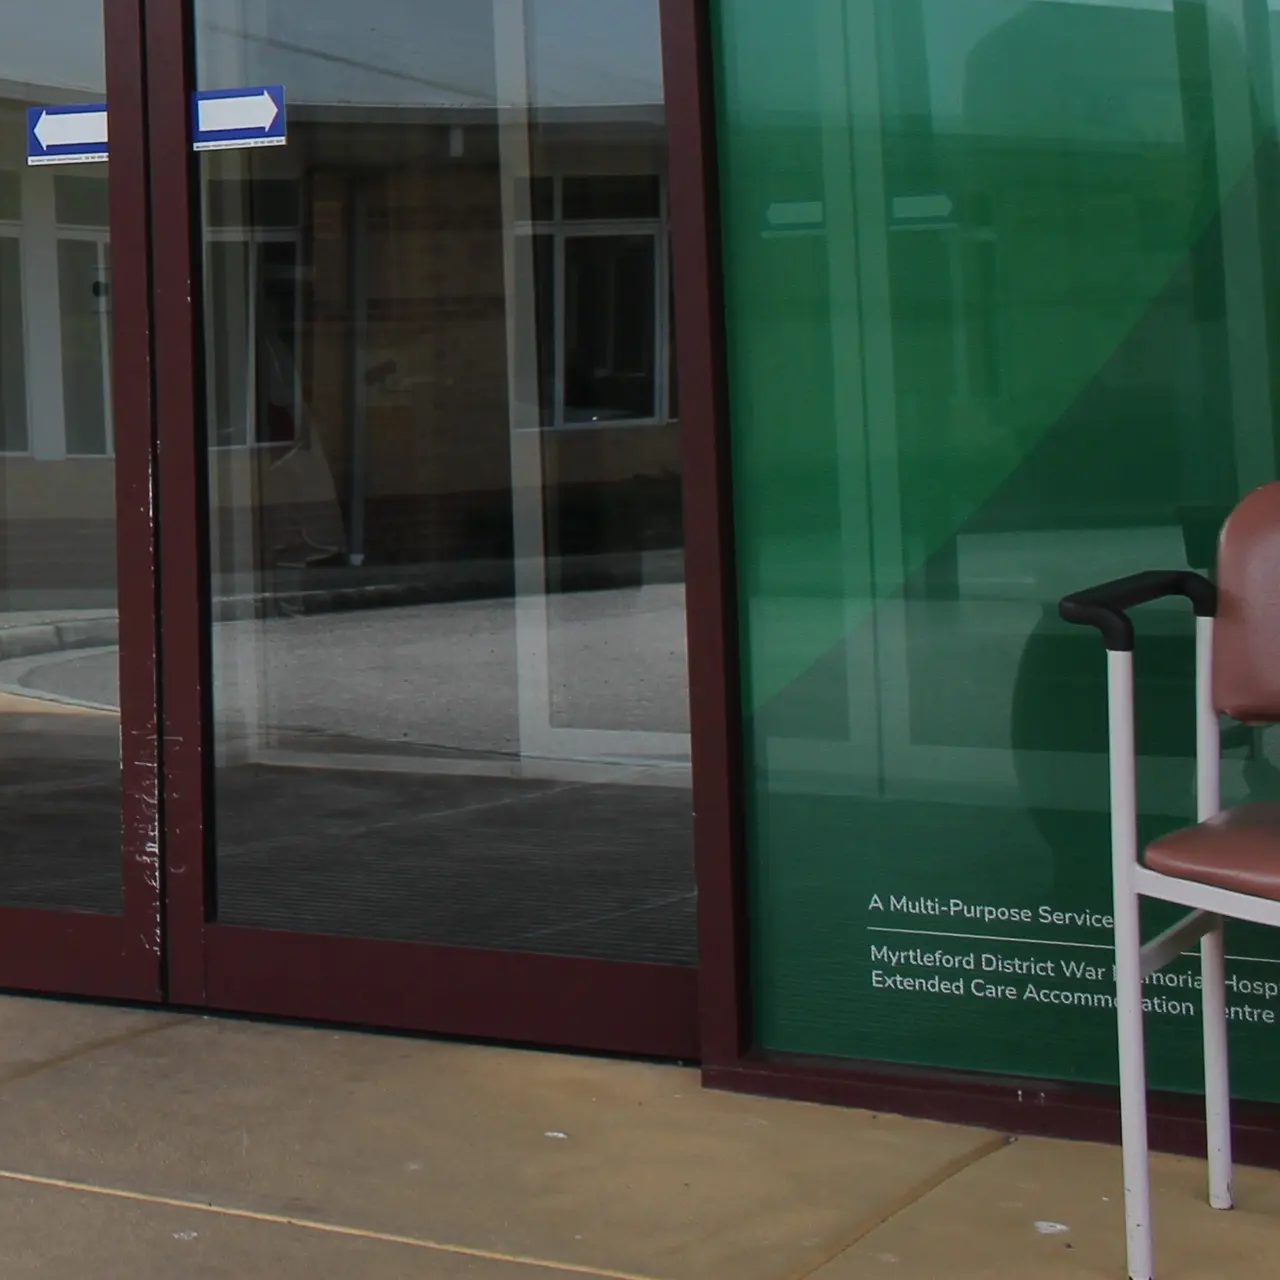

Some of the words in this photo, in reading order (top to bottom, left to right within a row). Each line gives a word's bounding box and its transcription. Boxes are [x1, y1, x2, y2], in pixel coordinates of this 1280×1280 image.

[868, 893, 884, 911] A
[889, 895, 1032, 922] Multi-Purpose
[1038, 905, 1114, 928] Service
[870, 944, 975, 969] Myrtleford
[981, 953, 1056, 976] District
[1060, 960, 1106, 981] War
[1112, 964, 1203, 990] moria
[1224, 973, 1280, 1000] Hosp
[871, 970, 965, 996] Extended
[970, 979, 1018, 1000] Care
[1023, 983, 1195, 1017] Accommation
[1224, 1004, 1276, 1024] ntre
